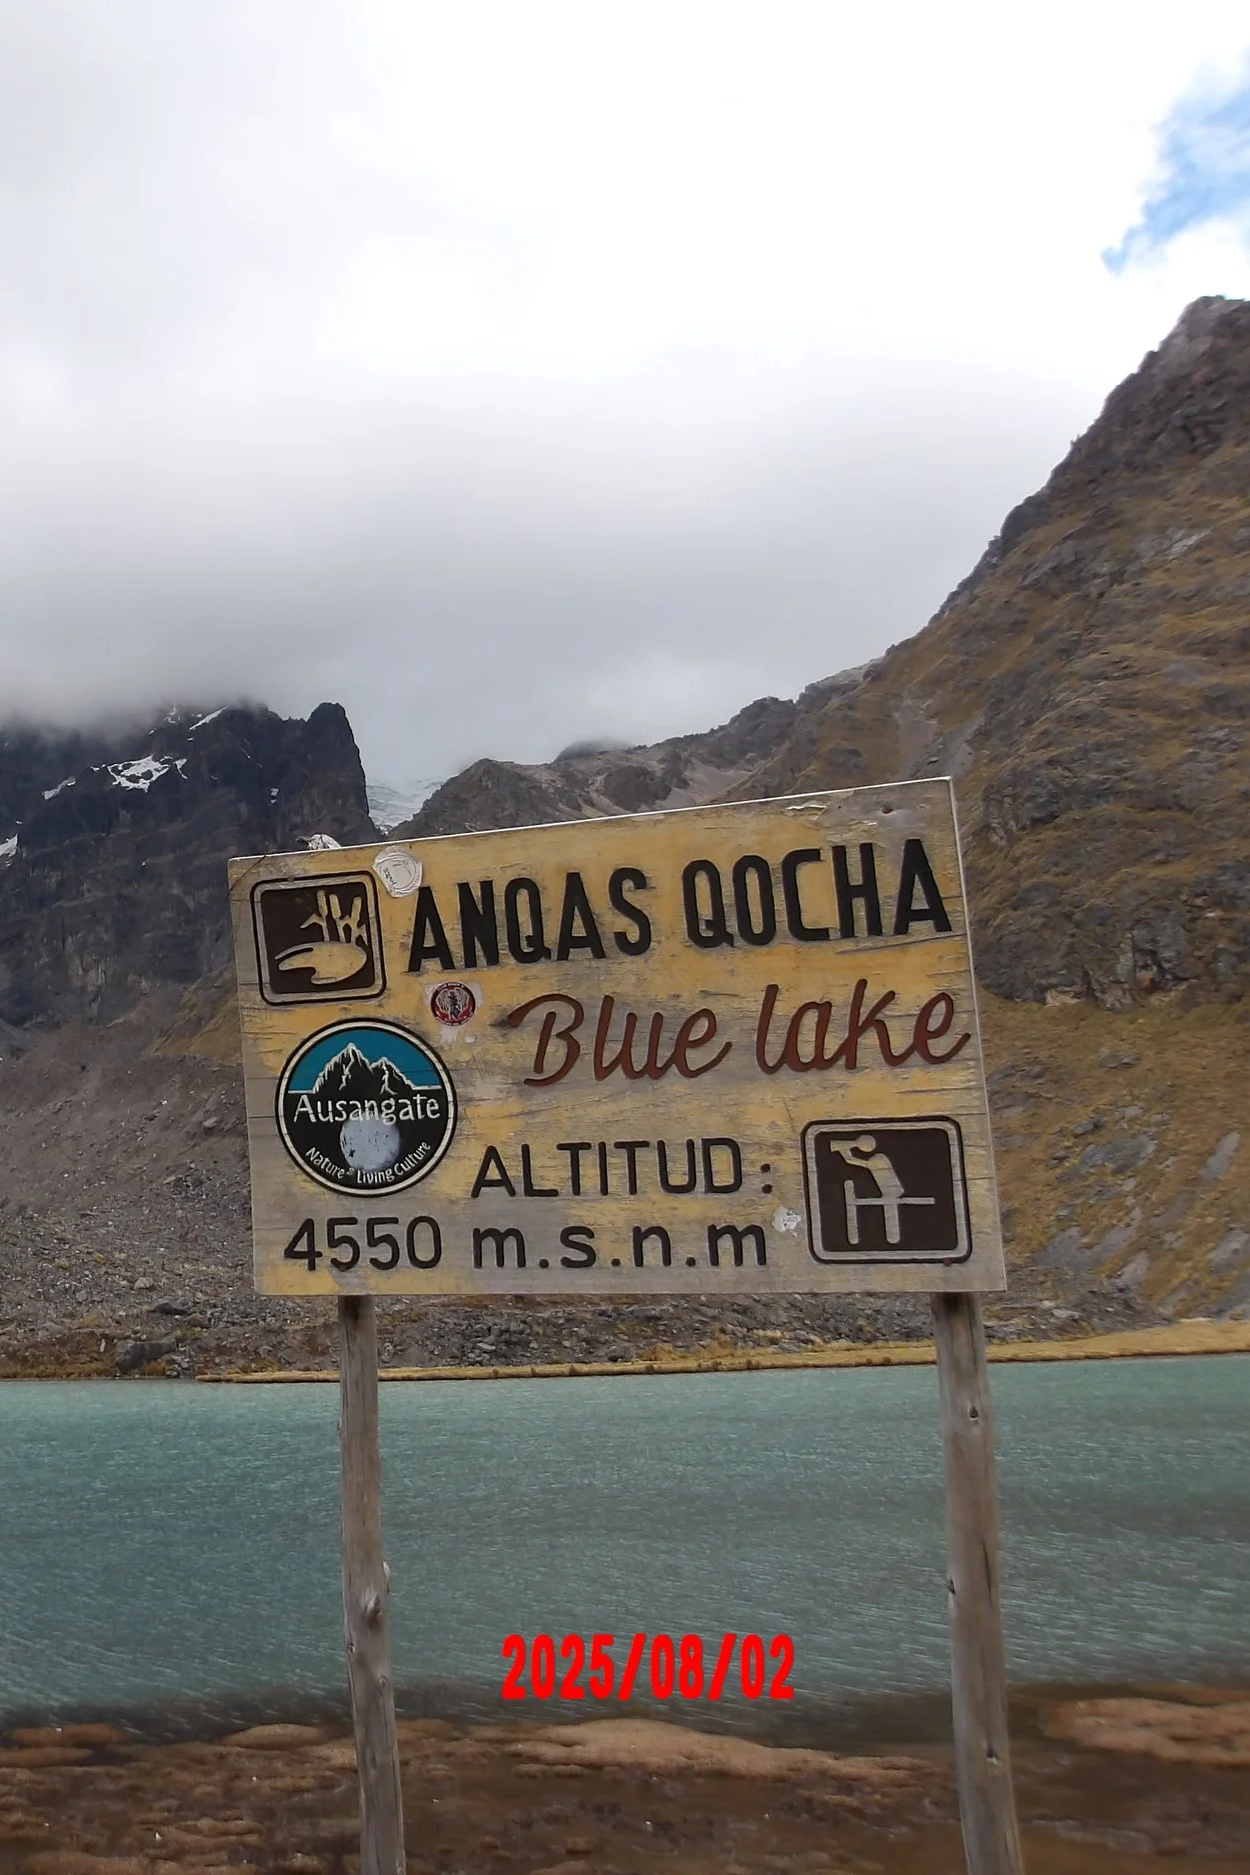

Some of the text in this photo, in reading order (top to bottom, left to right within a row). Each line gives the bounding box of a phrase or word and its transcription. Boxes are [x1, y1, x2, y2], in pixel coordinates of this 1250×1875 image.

[406, 838, 953, 973] ANQAS QOCHA
[506, 978, 972, 1087] Blue lake
[293, 1094, 441, 1126] Ausangate
[305, 1146, 345, 1179] Nature
[356, 1168, 395, 1184] Living
[393, 1141, 431, 1176] Culture
[283, 1215, 767, 1272] 4550 m.s.n.m
